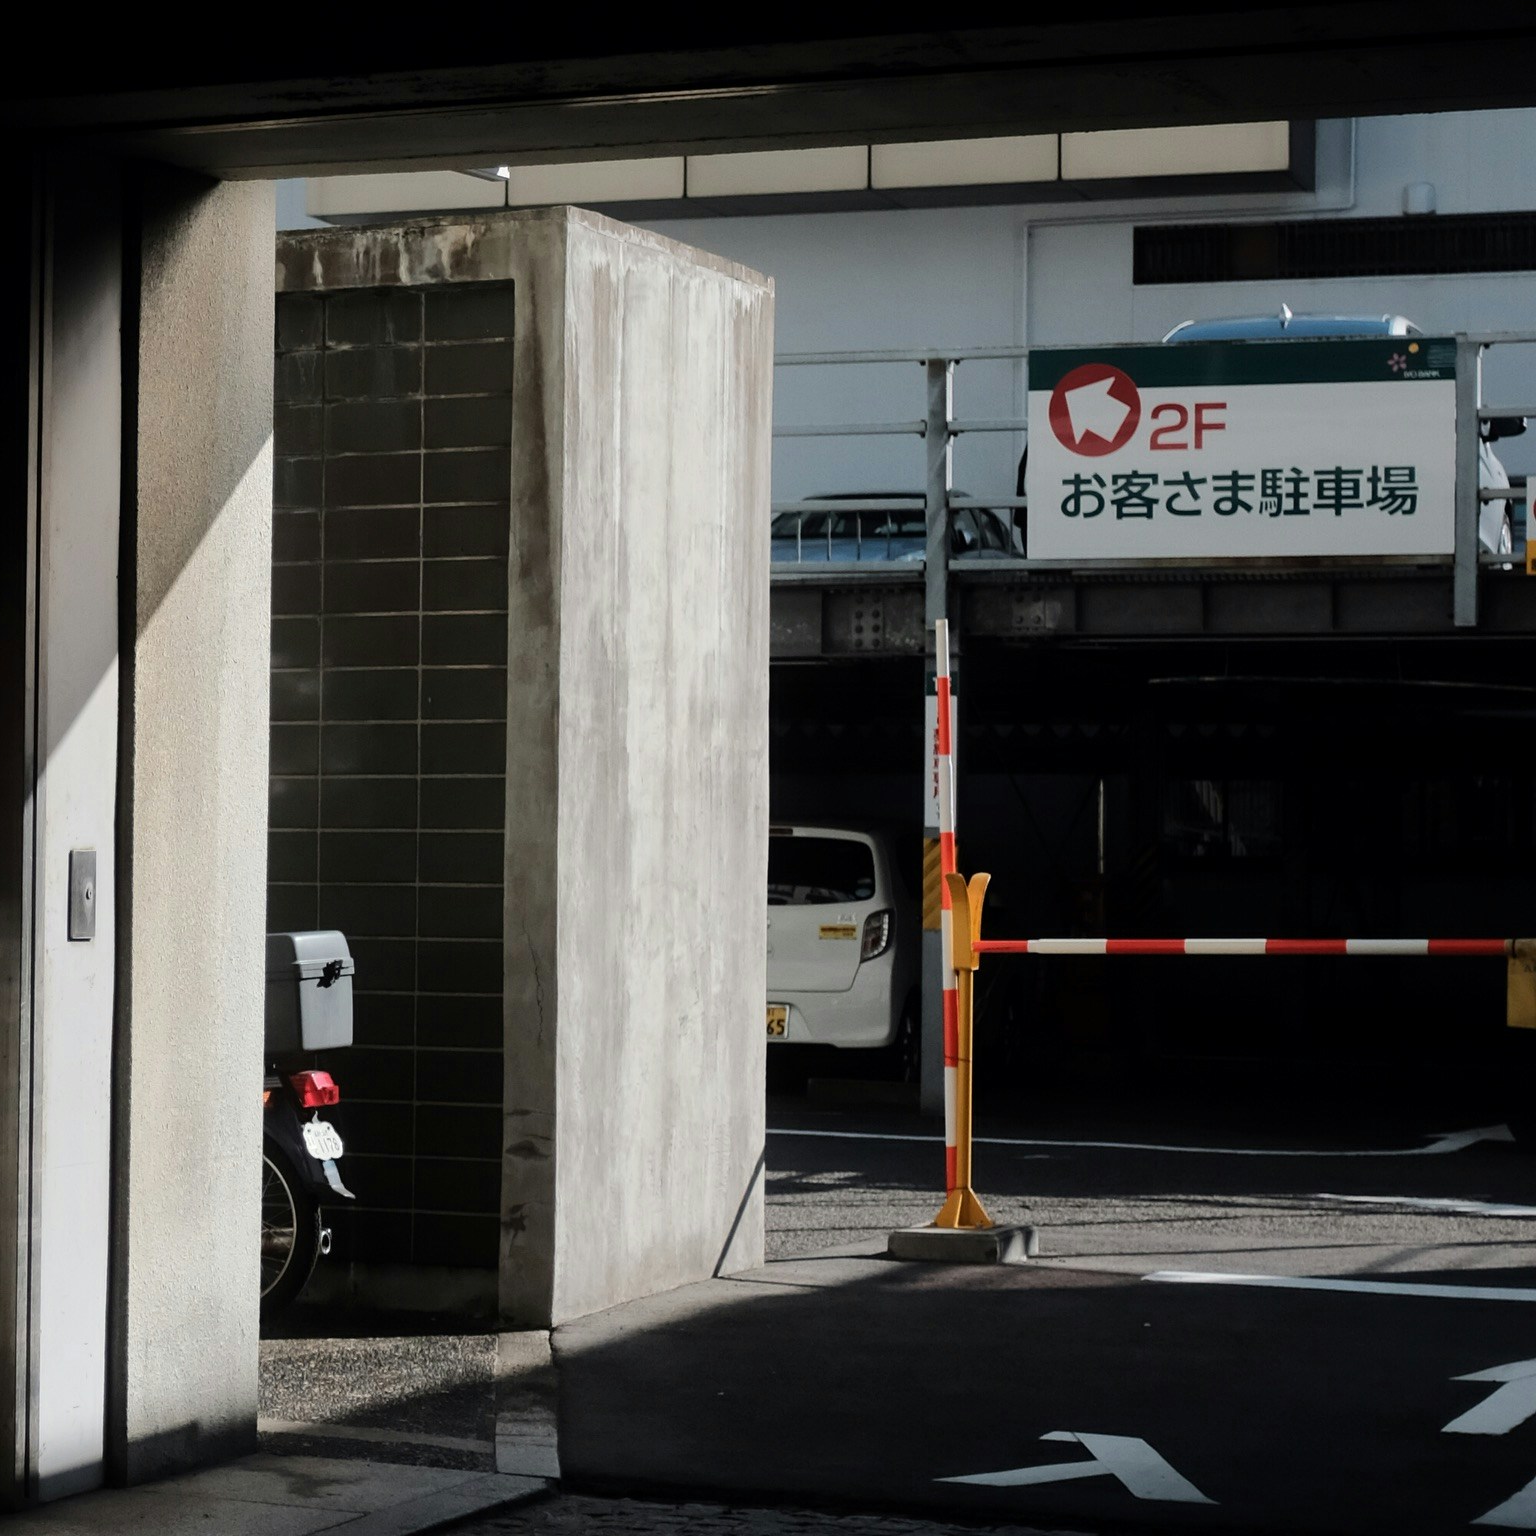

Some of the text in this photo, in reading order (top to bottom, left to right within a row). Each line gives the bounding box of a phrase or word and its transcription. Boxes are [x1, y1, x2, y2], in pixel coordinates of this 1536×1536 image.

[1149, 402, 1228, 452] 2F
[1060, 465, 1419, 521] お客さま駐車場
